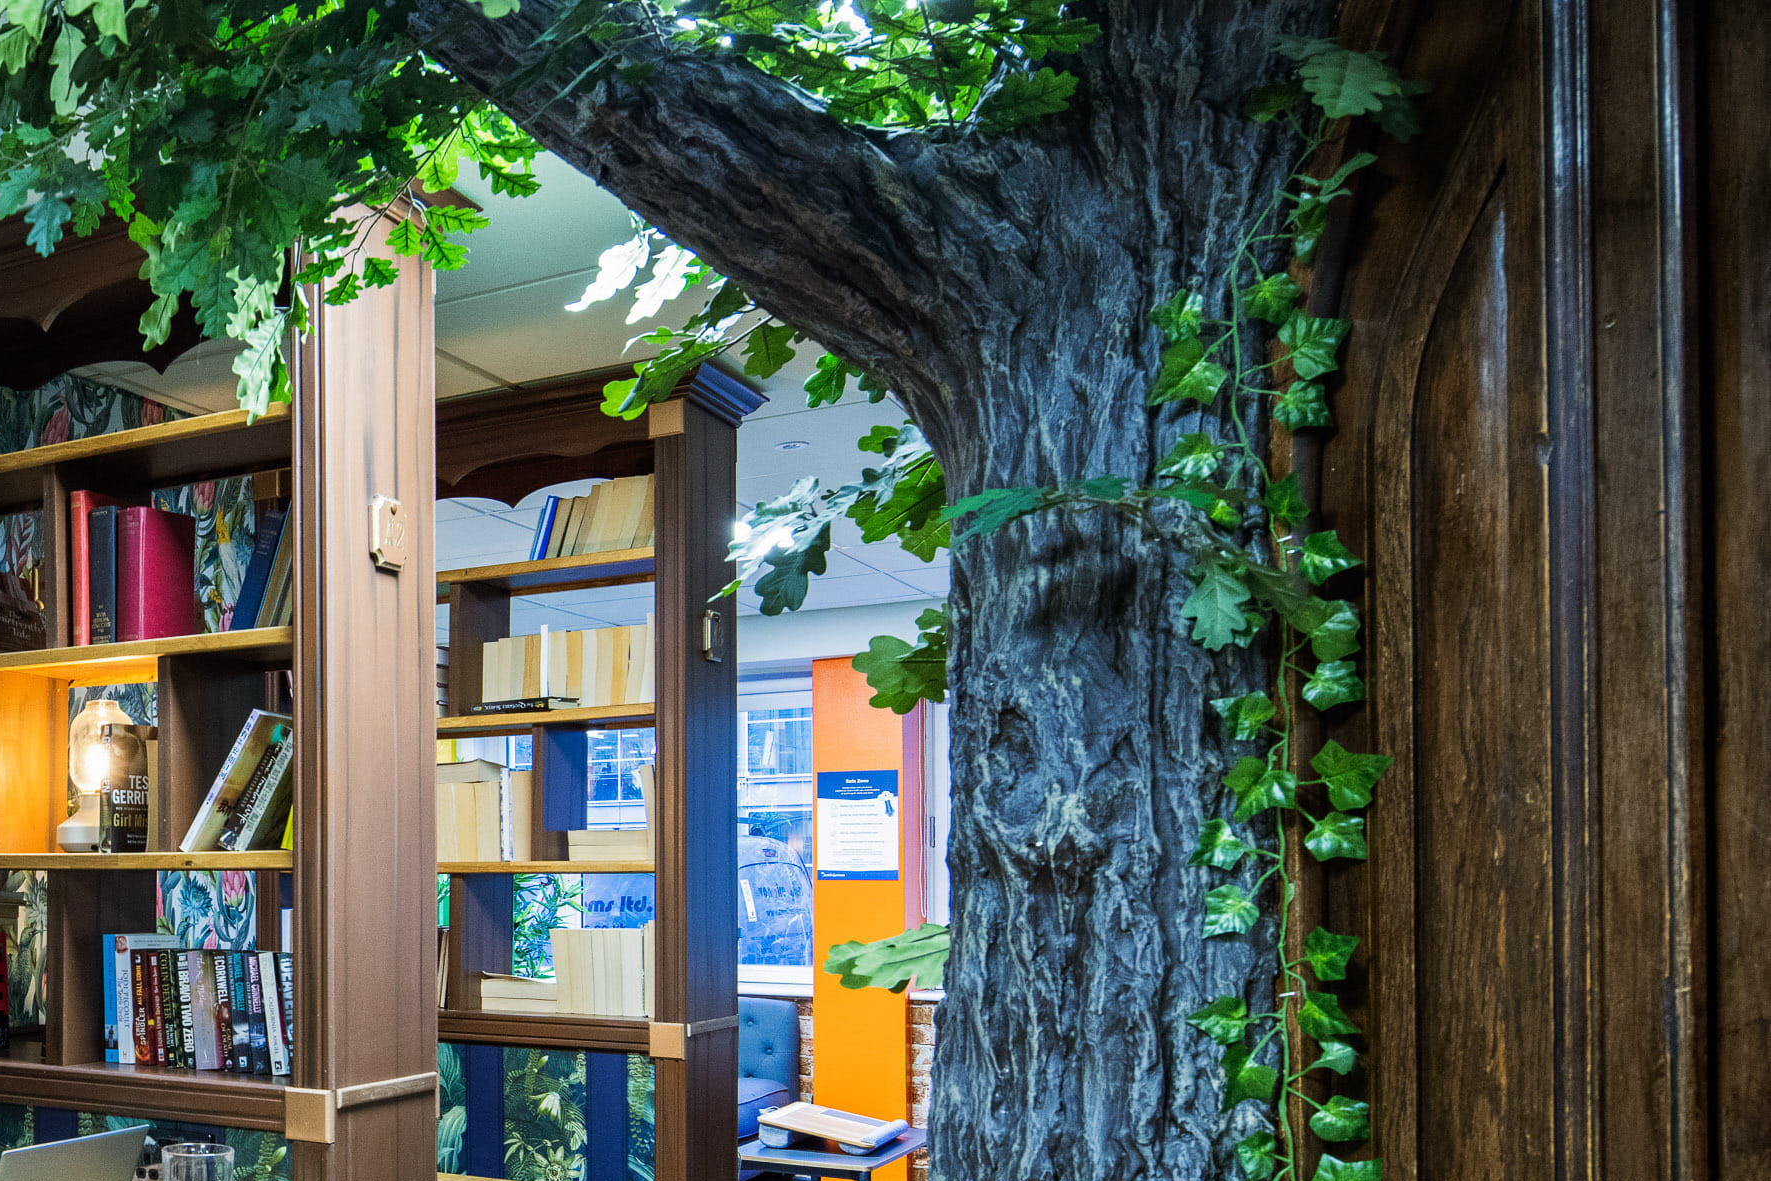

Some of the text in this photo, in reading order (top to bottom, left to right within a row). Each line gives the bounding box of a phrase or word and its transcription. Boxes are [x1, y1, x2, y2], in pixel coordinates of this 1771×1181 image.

[112, 789, 148, 805] GERRIT
[129, 775, 148, 790] TES
[114, 813, 132, 827] Girl
[620, 895, 653, 913] ltd.
[160, 952, 169, 983] COLIN
[215, 959, 229, 1004] CORNWELL
[233, 952, 246, 1011] MICHAEL CONNELLY
[248, 956, 262, 1014] MICHAEL CONNELLY
[121, 969, 132, 1029] JODI PICOULT
[162, 984, 173, 1020] DEXTER
[178, 970, 195, 1053] BRAVO TWO ZERO
[139, 1007, 147, 1046] SPINDLER
